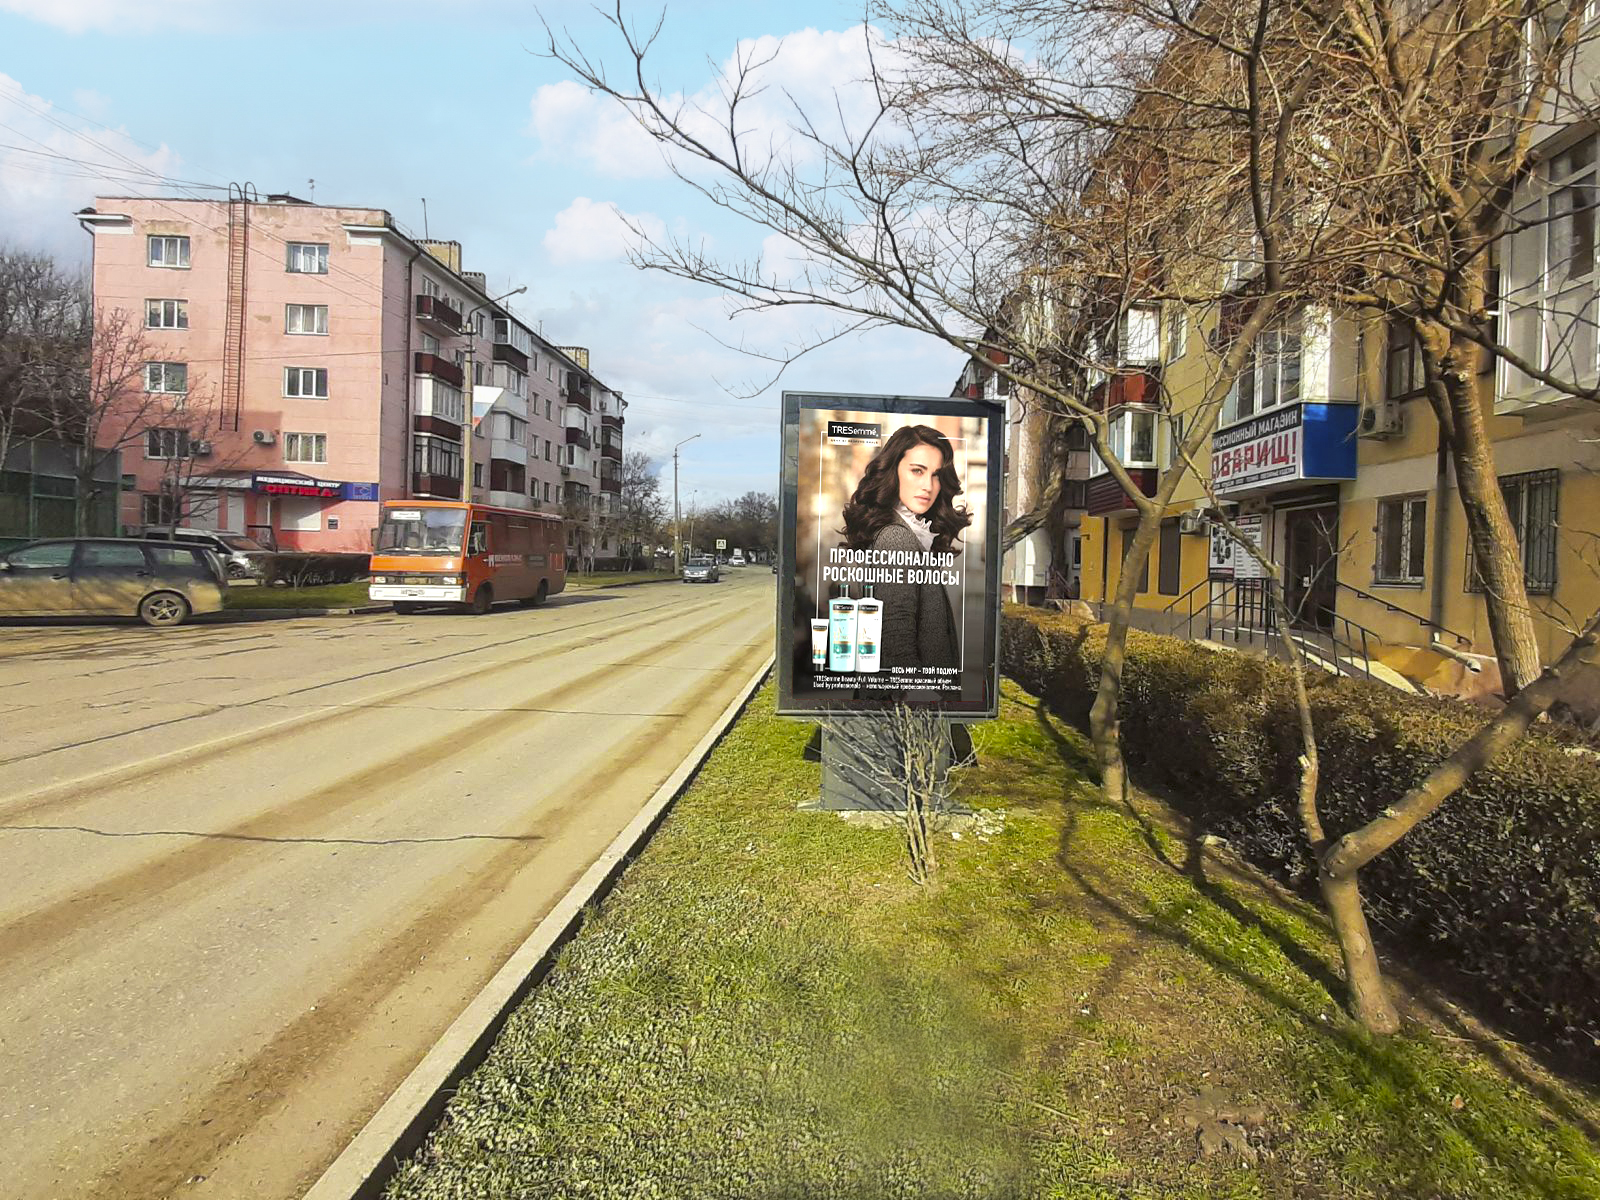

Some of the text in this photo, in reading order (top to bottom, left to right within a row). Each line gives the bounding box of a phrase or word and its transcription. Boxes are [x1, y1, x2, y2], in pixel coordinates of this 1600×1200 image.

[1258, 410, 1297, 436] МАГАЗИН
[829, 548, 954, 567] ПРОФЕССИОНАЛЬНО
[823, 566, 960, 586] РОСКОШНЫЕ ВОЛОСЫ
[891, 666, 905, 674] ВЕСЬ
[905, 666, 917, 674] МИР
[922, 666, 935, 674] ТВОЙ
